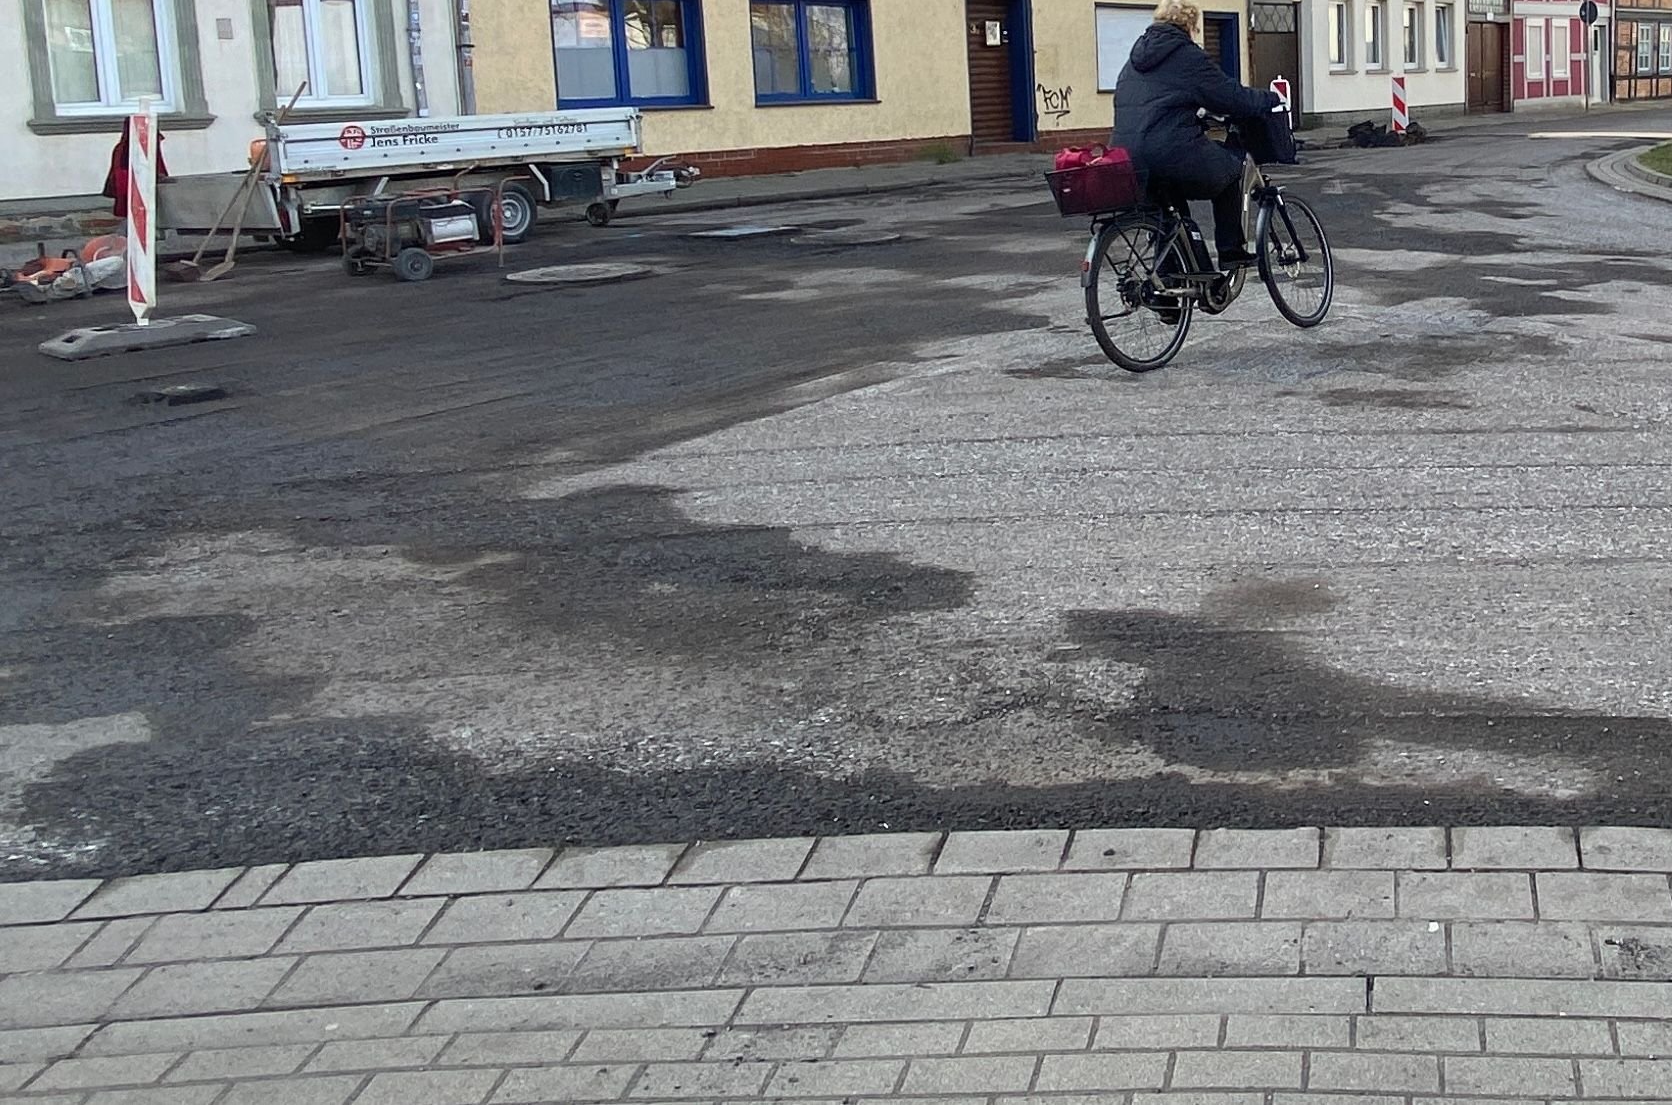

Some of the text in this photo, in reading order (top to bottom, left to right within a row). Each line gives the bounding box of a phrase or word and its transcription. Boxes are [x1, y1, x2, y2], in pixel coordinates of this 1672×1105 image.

[370, 123, 460, 134] Straßenbaumeister
[370, 134, 439, 147] Jens Fricke
